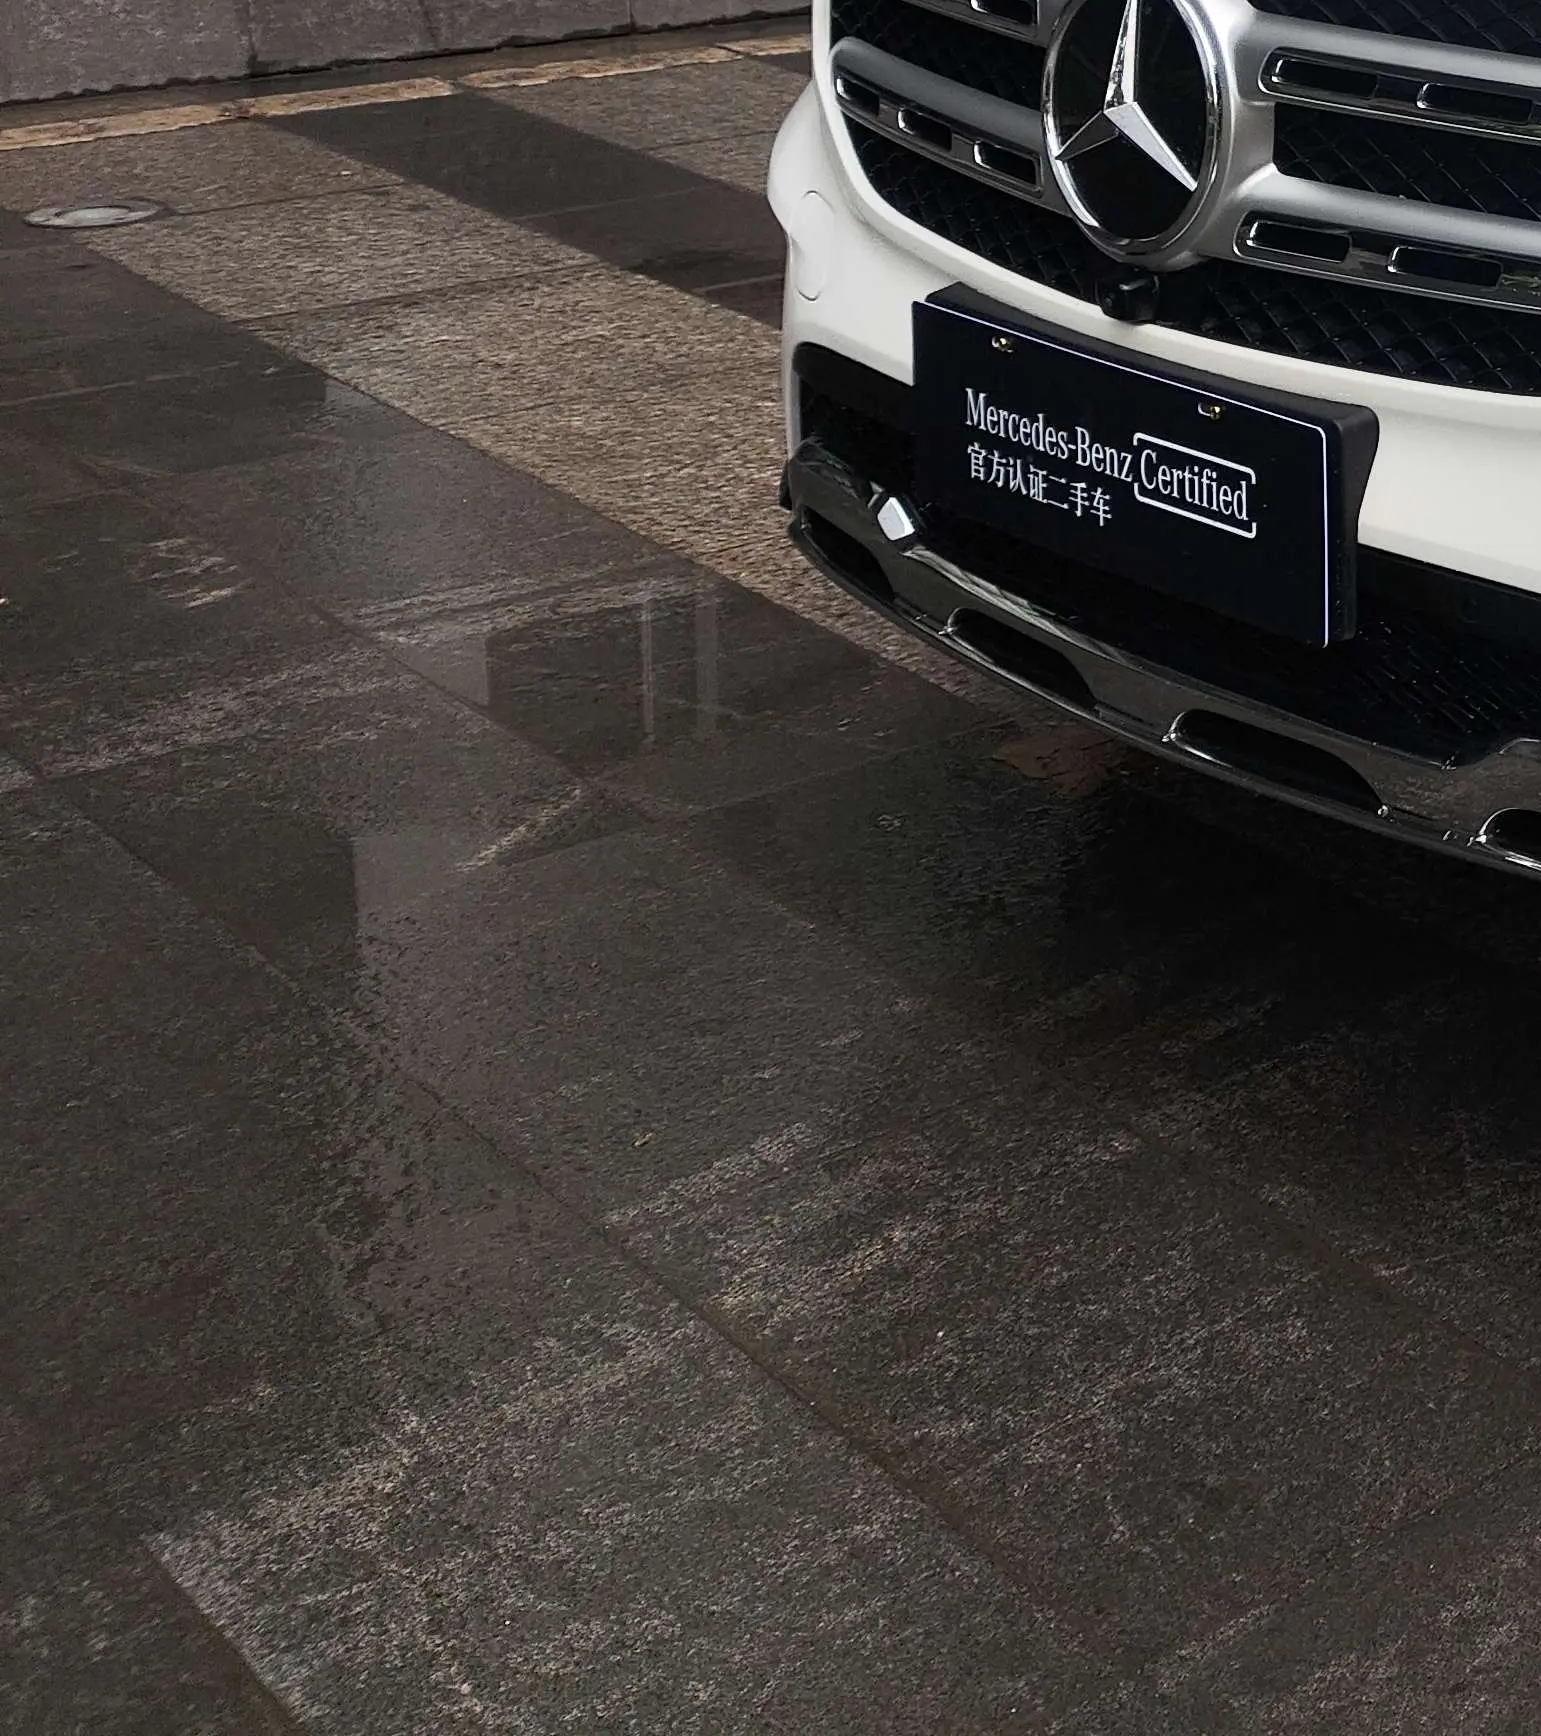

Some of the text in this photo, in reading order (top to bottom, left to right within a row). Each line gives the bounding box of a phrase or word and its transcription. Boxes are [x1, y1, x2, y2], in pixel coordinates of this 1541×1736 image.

[964, 387, 1249, 522] Mercedes-Benz Certified
[966, 442, 1113, 527] 官方认证二手车
